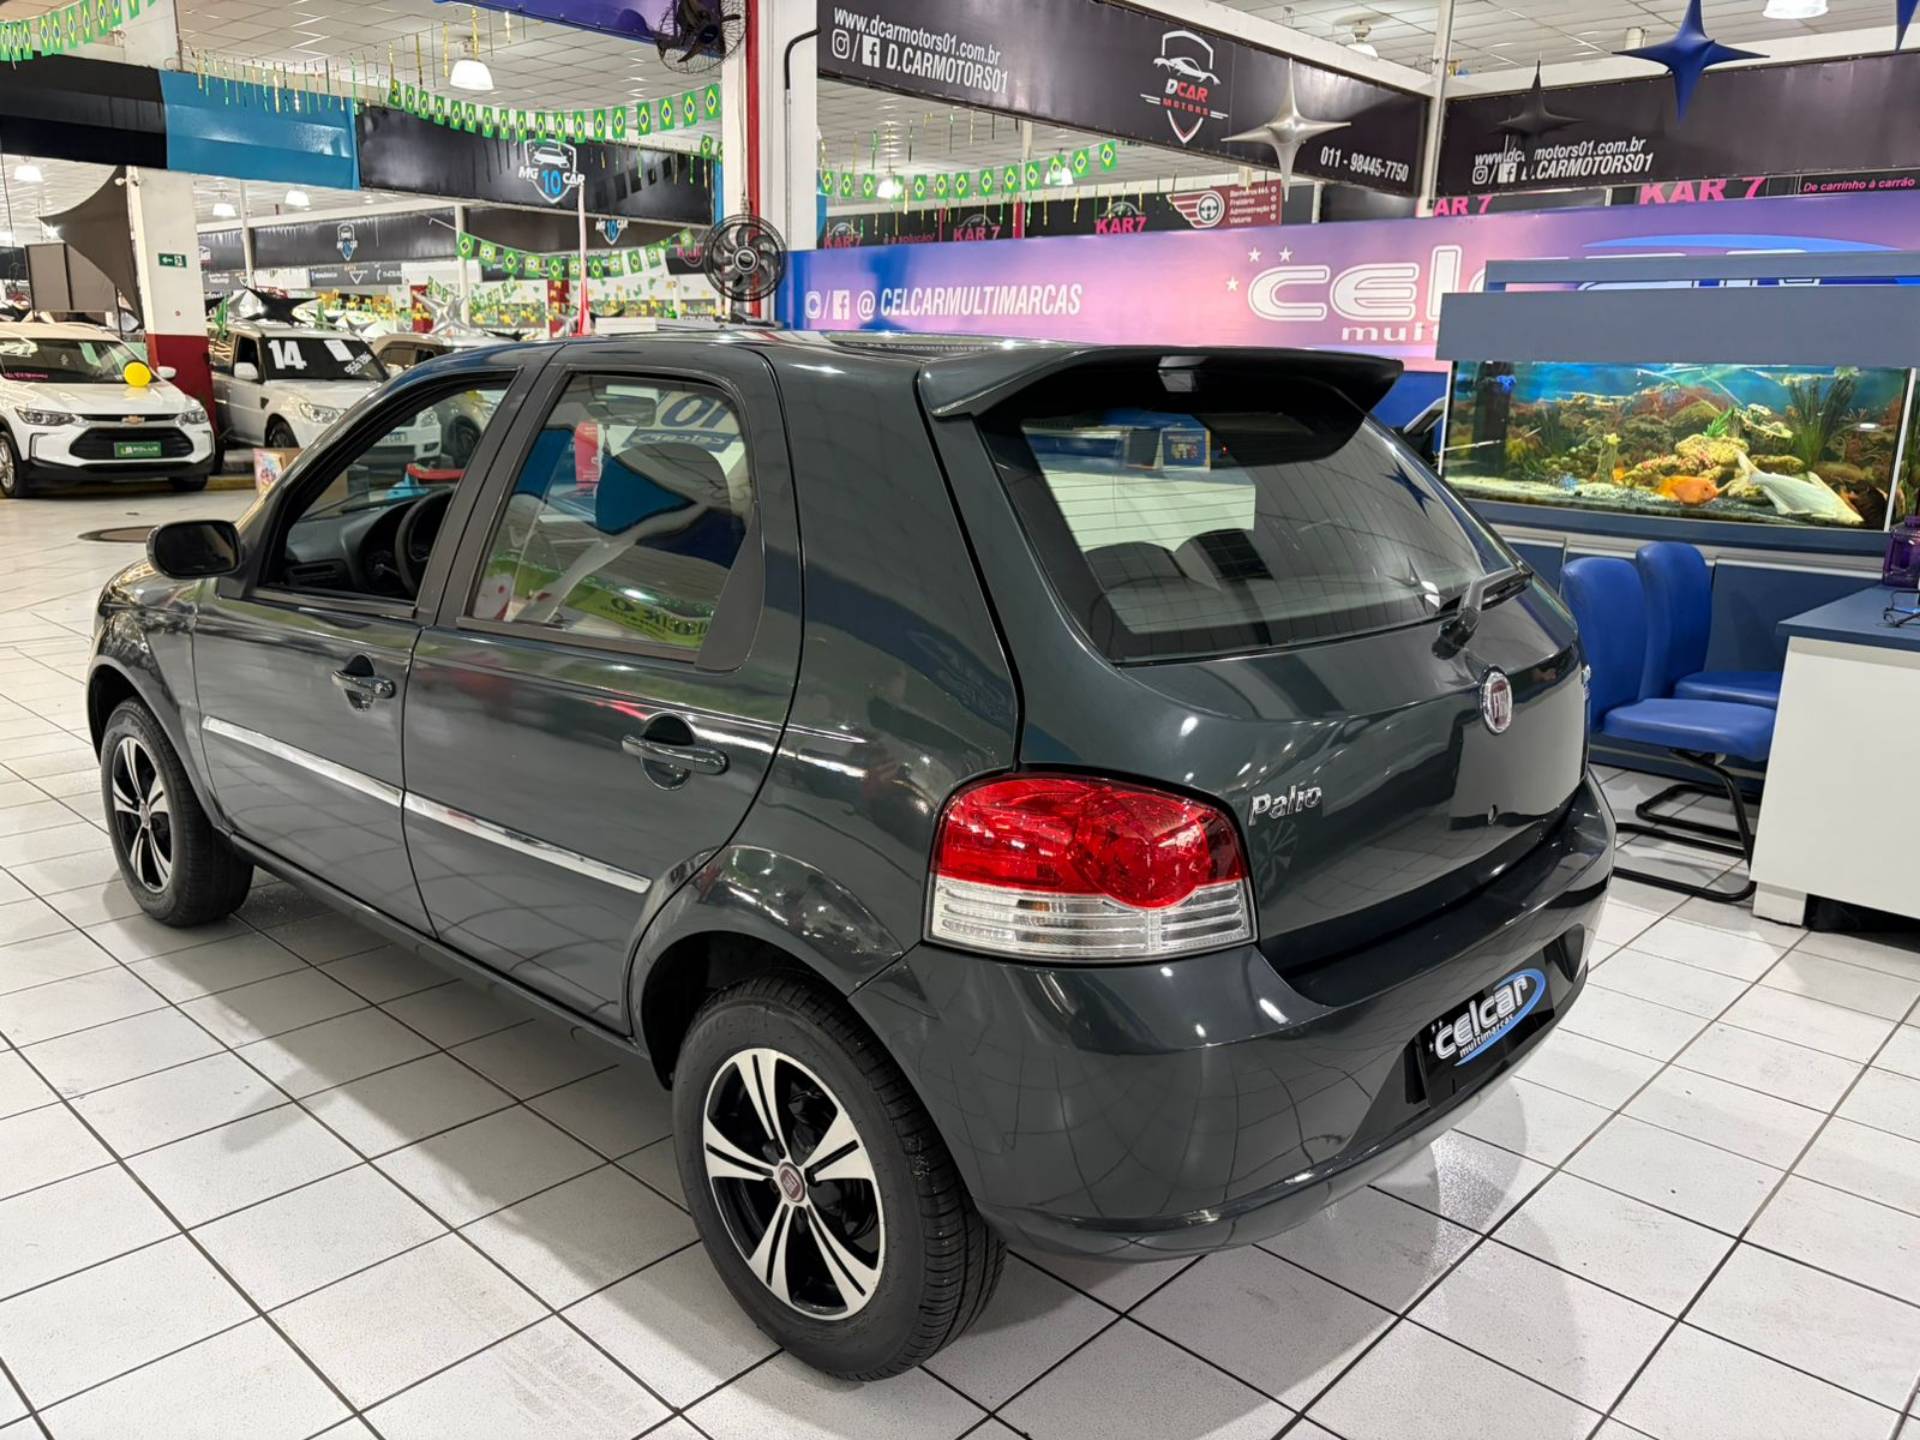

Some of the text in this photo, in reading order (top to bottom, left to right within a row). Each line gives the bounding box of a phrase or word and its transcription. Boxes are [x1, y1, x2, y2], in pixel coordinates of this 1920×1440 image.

[834, 7, 1000, 65] www.dcarmotors01.com.br
[886, 43, 1008, 93] D.CARMOTORS01
[1165, 78, 1208, 103] DCAR
[1163, 98, 1208, 116] MOTORS
[1320, 146, 1341, 167] 011
[1350, 151, 1409, 182] 98445-7750
[1475, 136, 1646, 166] www.dcmotors01.com.br
[518, 166, 585, 195] MG 10 CAR
[1639, 177, 1766, 205] KAR 7
[1803, 182, 1816, 193] De
[1820, 180, 1866, 192] carrinho
[1880, 177, 1916, 188] carrão
[1433, 195, 1493, 216] AR 7
[953, 226, 986, 241] KAR
[880, 283, 1083, 317] CELCARMULTIMARCAS
[267, 339, 307, 370] 14
[1249, 784, 1322, 827] Palio
[1435, 975, 1528, 1060] celcar
